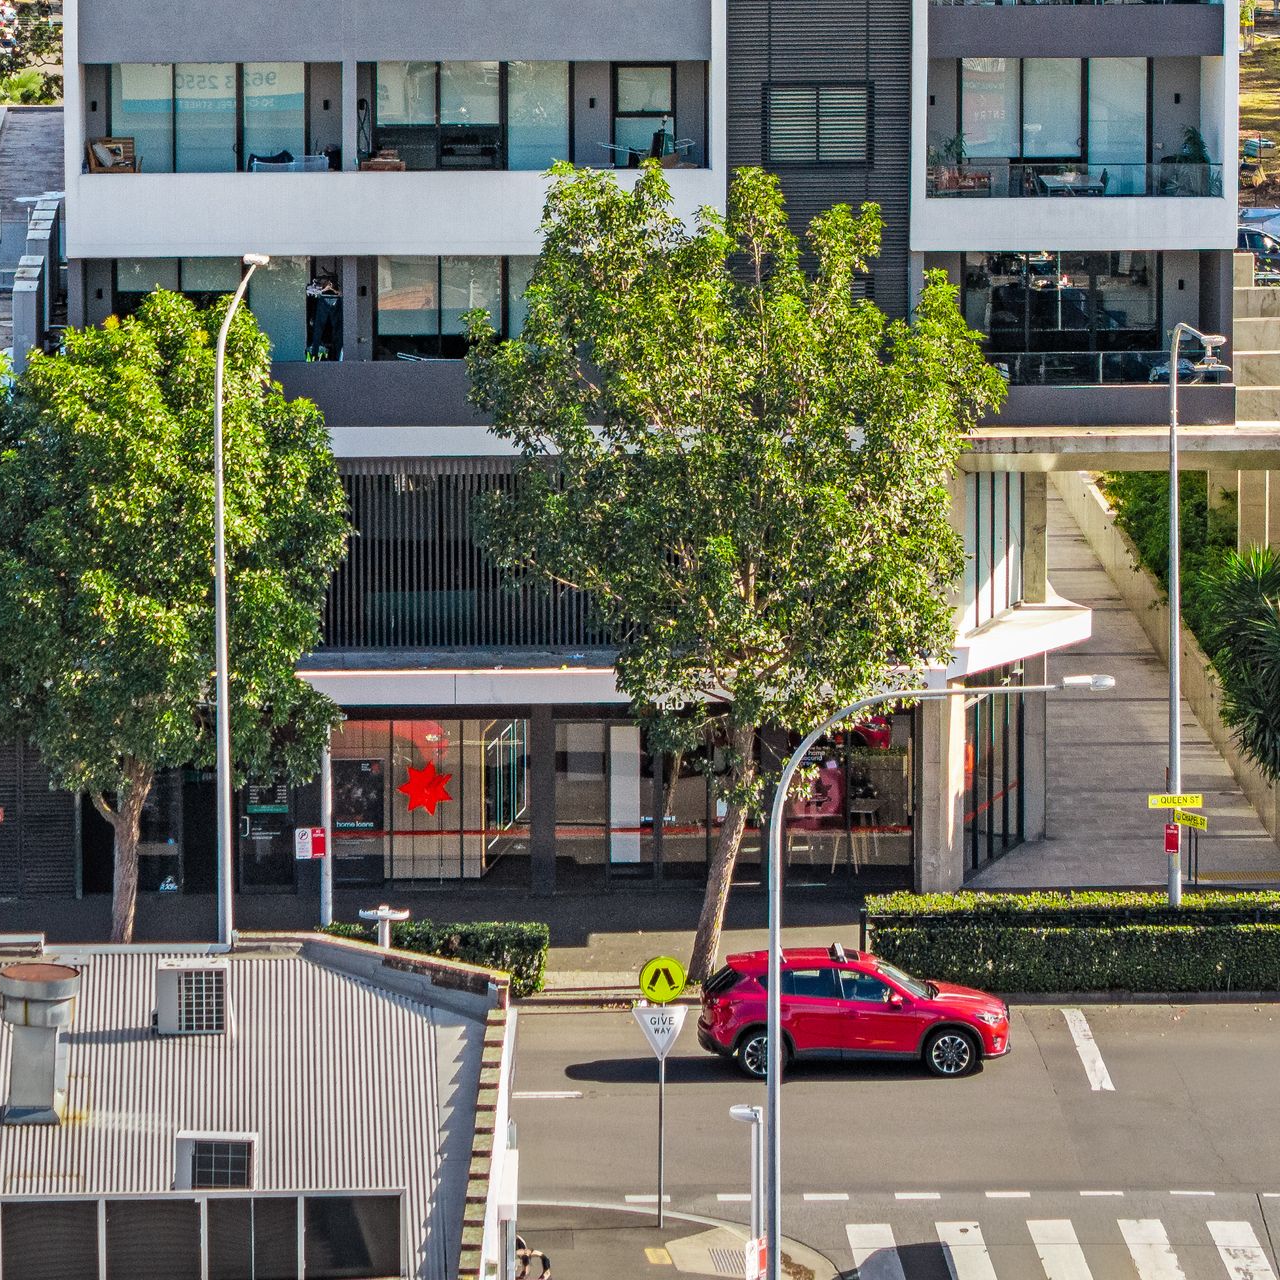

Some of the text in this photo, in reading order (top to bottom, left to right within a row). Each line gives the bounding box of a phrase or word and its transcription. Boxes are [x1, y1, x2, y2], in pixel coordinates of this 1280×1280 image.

[1160, 796, 1188, 804] QUEEN
[650, 1016, 675, 1026] GIVE
[653, 1027, 671, 1035] WAY
